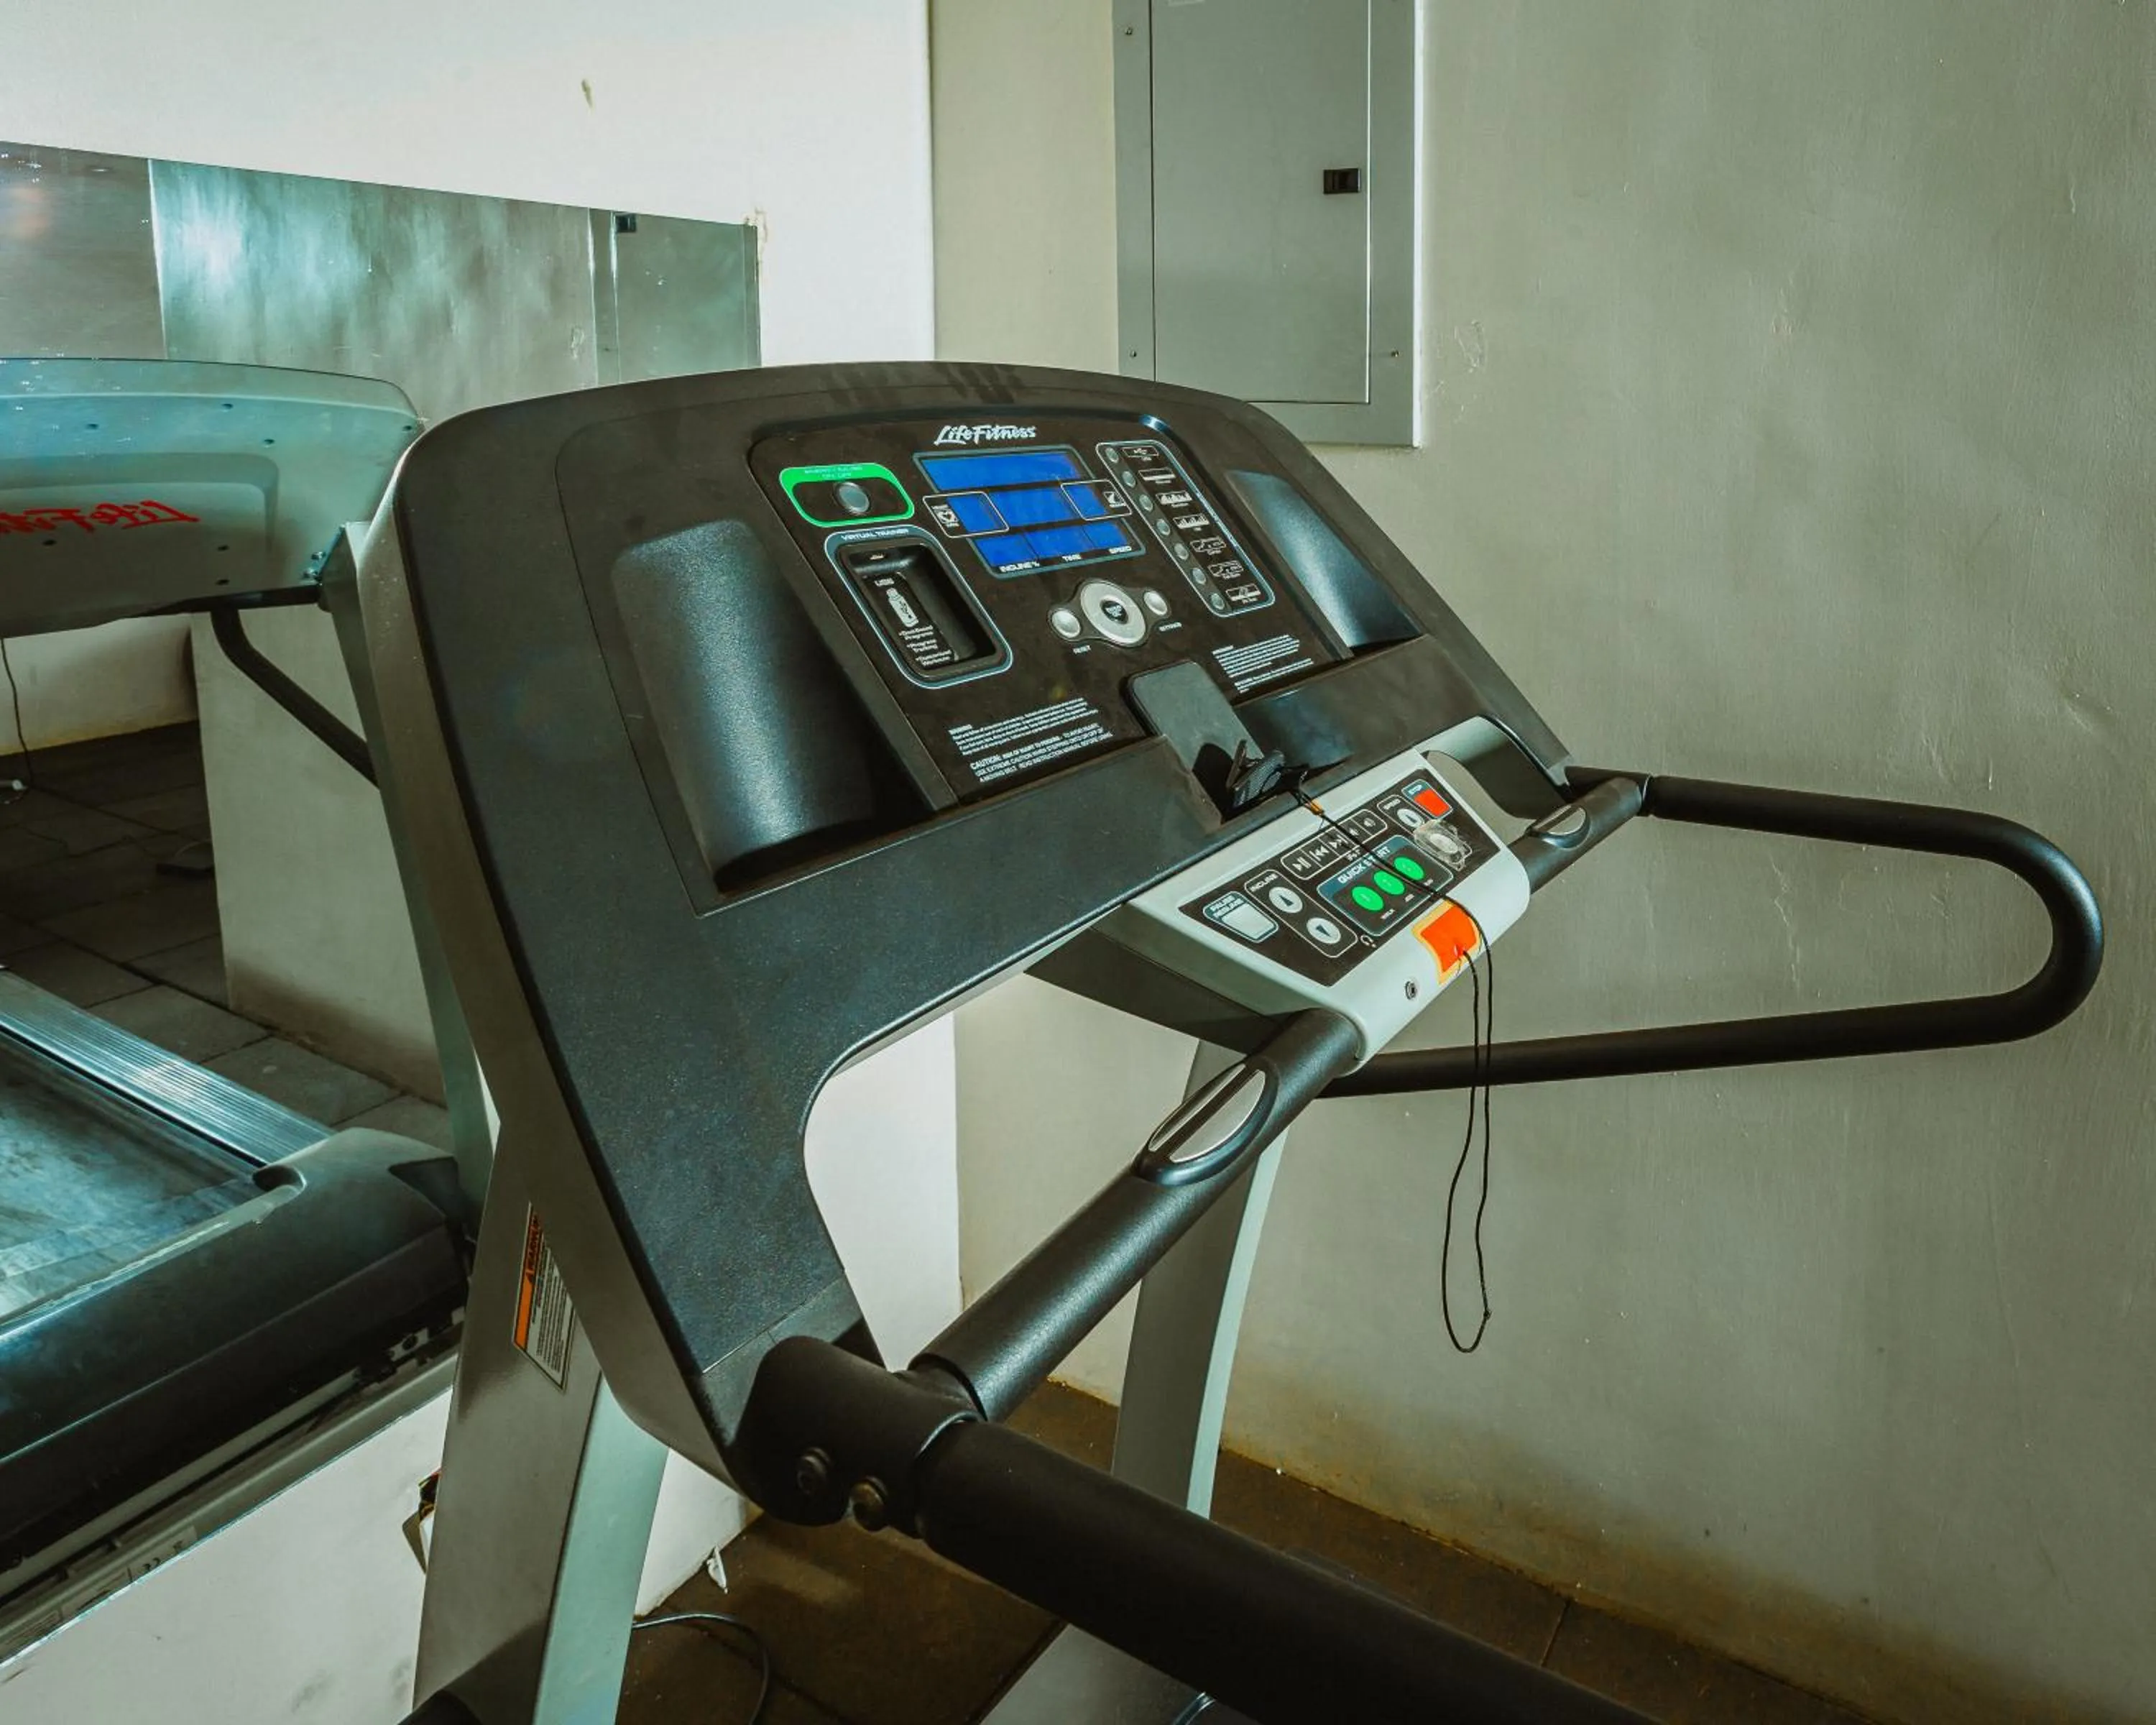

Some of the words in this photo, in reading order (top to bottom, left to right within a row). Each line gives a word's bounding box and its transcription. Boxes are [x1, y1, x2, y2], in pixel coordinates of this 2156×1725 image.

[841, 532, 877, 540] VIRTUAL
[1337, 863, 1365, 883] QUICK
[1363, 846, 1391, 868] STRT
